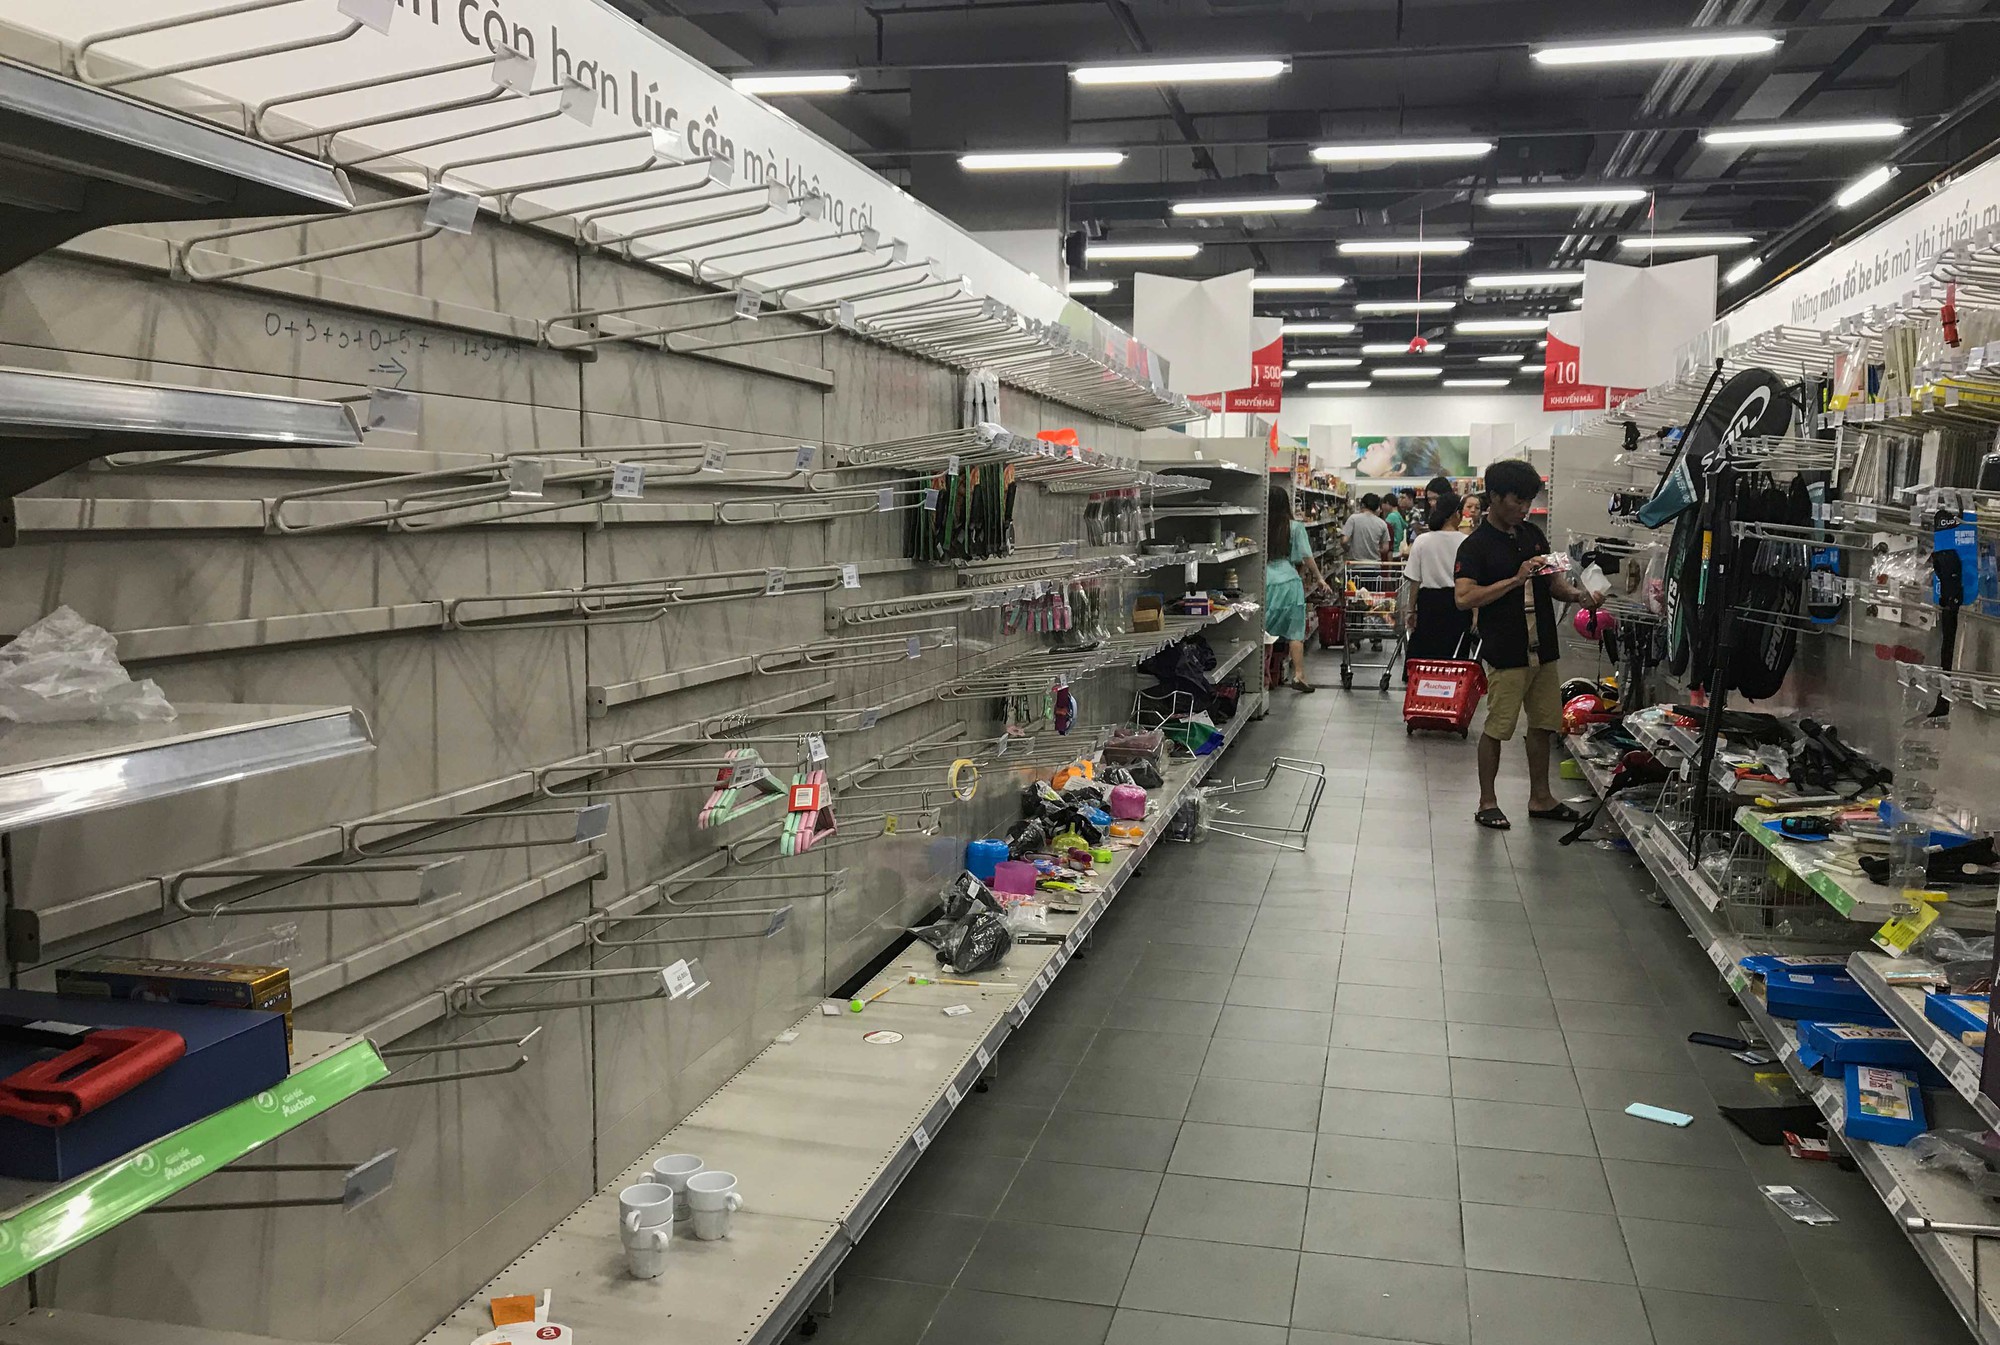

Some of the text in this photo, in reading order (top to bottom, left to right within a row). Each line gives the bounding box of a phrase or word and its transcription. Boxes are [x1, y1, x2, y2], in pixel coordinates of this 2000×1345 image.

[459, 0, 535, 59] còn
[551, 25, 619, 115] hơn
[743, 147, 778, 186] mà
[1791, 293, 1819, 325] Những
[1820, 278, 1841, 312] món
[1859, 263, 1872, 294] be
[1874, 249, 1889, 286] bé
[1891, 239, 1911, 279] mà
[1914, 225, 1936, 268] khi
[1939, 198, 1978, 250] thiếu
[1556, 361, 1577, 384] 10
[1423, 681, 1451, 691] Auchan
[282, 1095, 316, 1117] Auchan
[164, 1154, 205, 1180] Auchan
